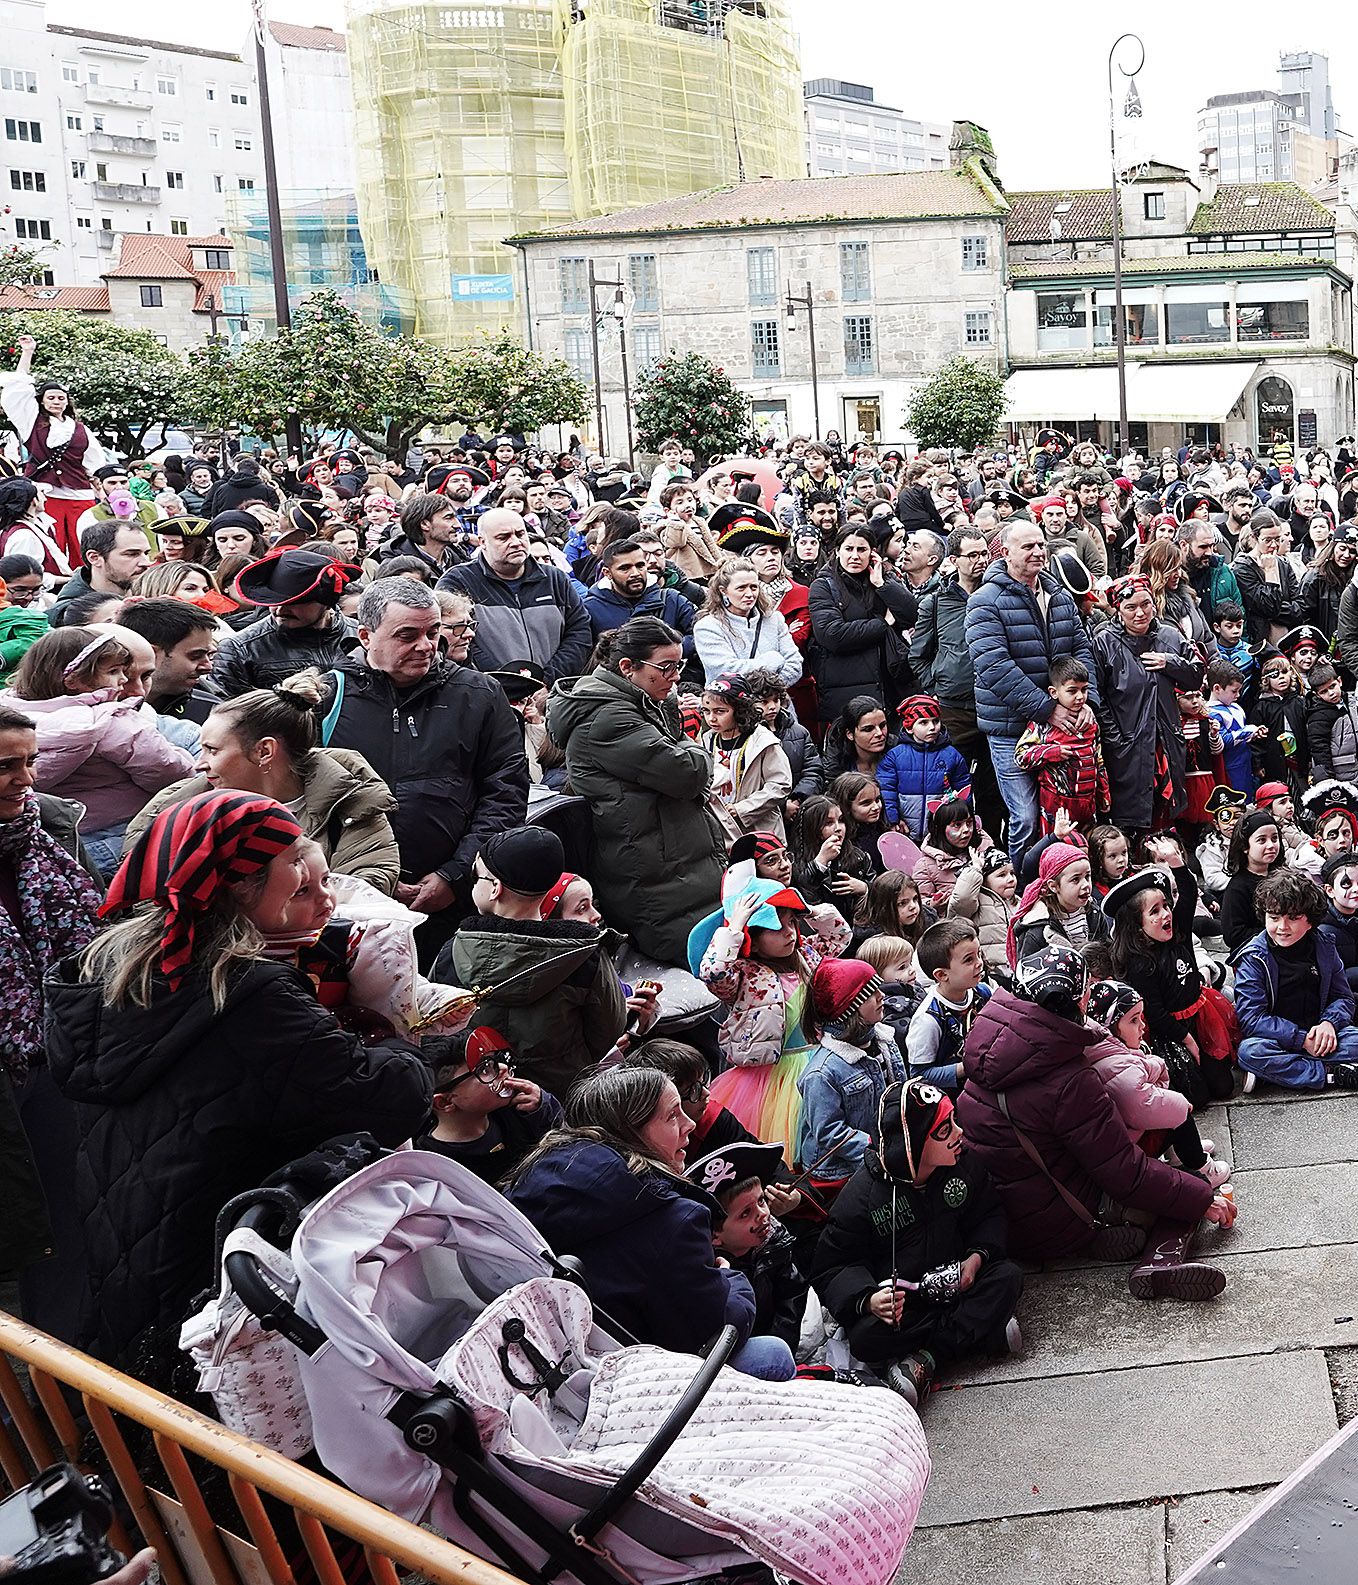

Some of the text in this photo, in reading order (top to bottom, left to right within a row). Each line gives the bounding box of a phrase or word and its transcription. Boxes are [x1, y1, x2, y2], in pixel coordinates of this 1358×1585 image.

[1047, 311, 1077, 322] Savoy
[1261, 402, 1289, 414] Savoy
[943, 1177, 967, 1194] CELTICS
